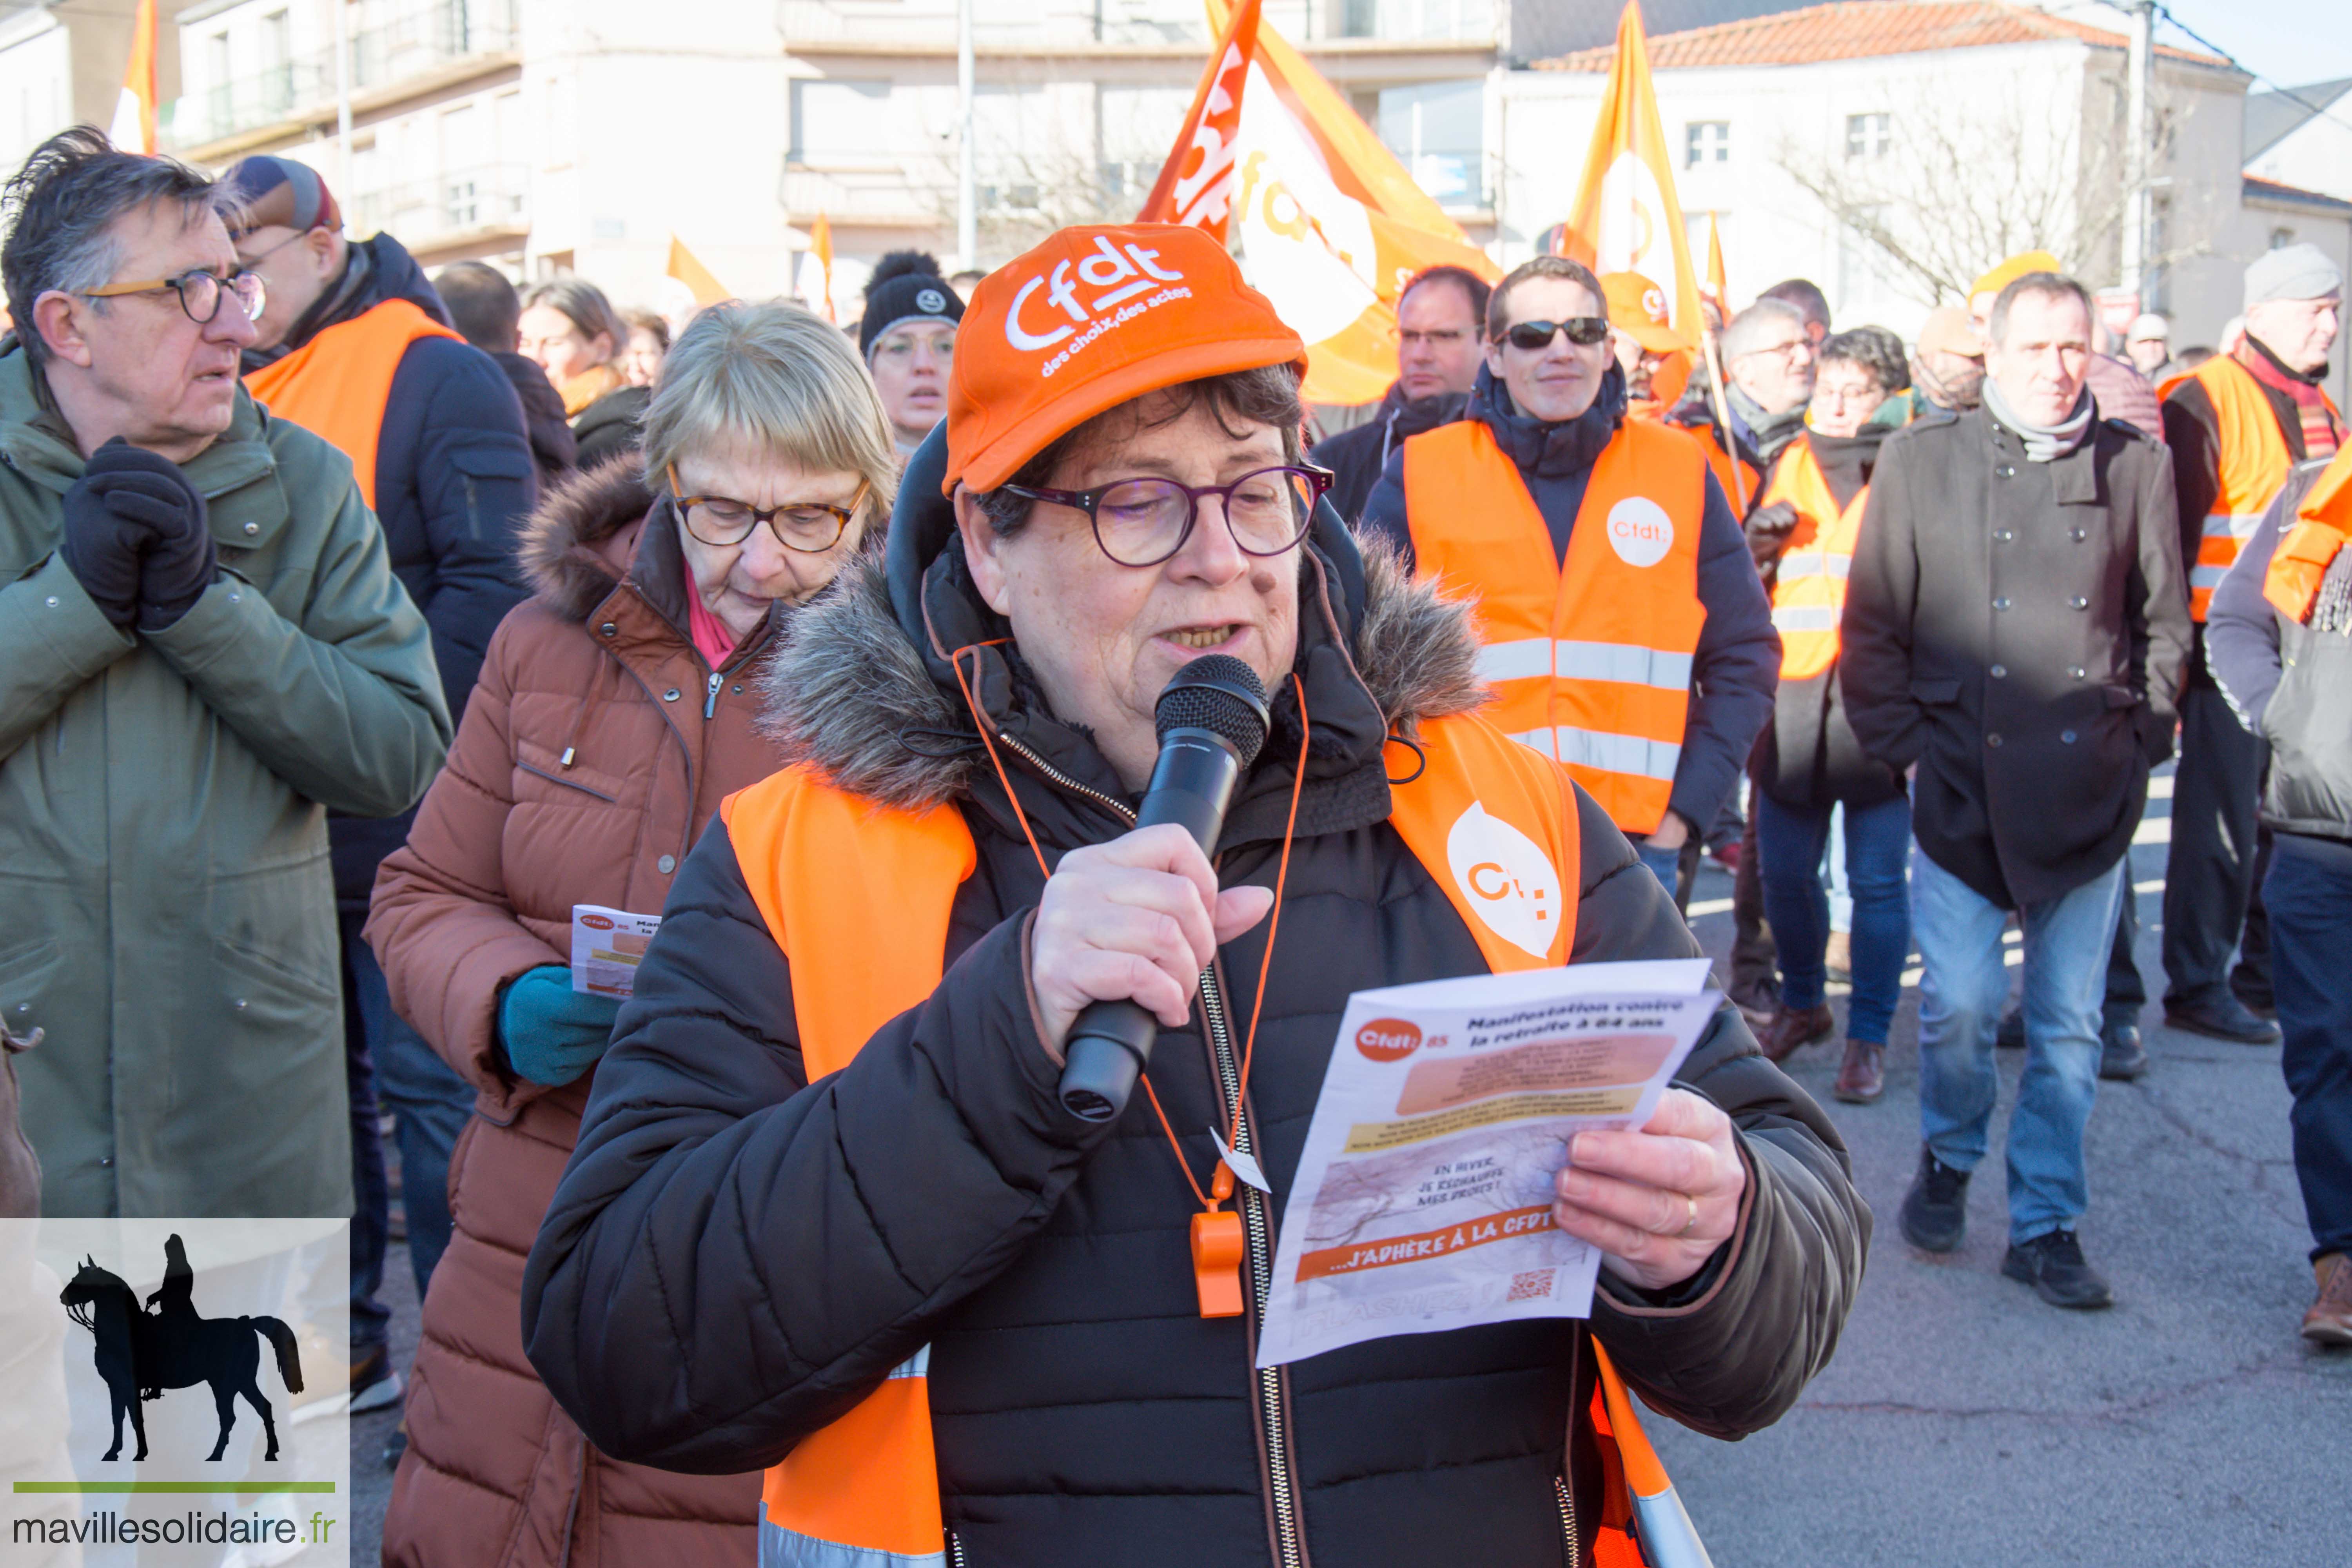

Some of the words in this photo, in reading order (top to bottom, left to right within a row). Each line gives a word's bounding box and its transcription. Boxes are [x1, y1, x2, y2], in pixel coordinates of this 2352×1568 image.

[1005, 236, 1184, 351] Cfdt
[1042, 350, 1070, 377] des
[1116, 302, 1147, 322] des
[1147, 287, 1192, 308] actes
[1467, 1002, 1609, 1031] Manifestation
[1615, 1000, 1684, 1012] contre
[1470, 1036, 1488, 1048] la
[1494, 1019, 1570, 1043] retraite
[1629, 1019, 1664, 1029] ans
[1417, 1192, 1448, 1206] MES
[1450, 1227, 1466, 1249] À
[1472, 1221, 1498, 1242] LA
[1503, 1212, 1553, 1235] CFDT
